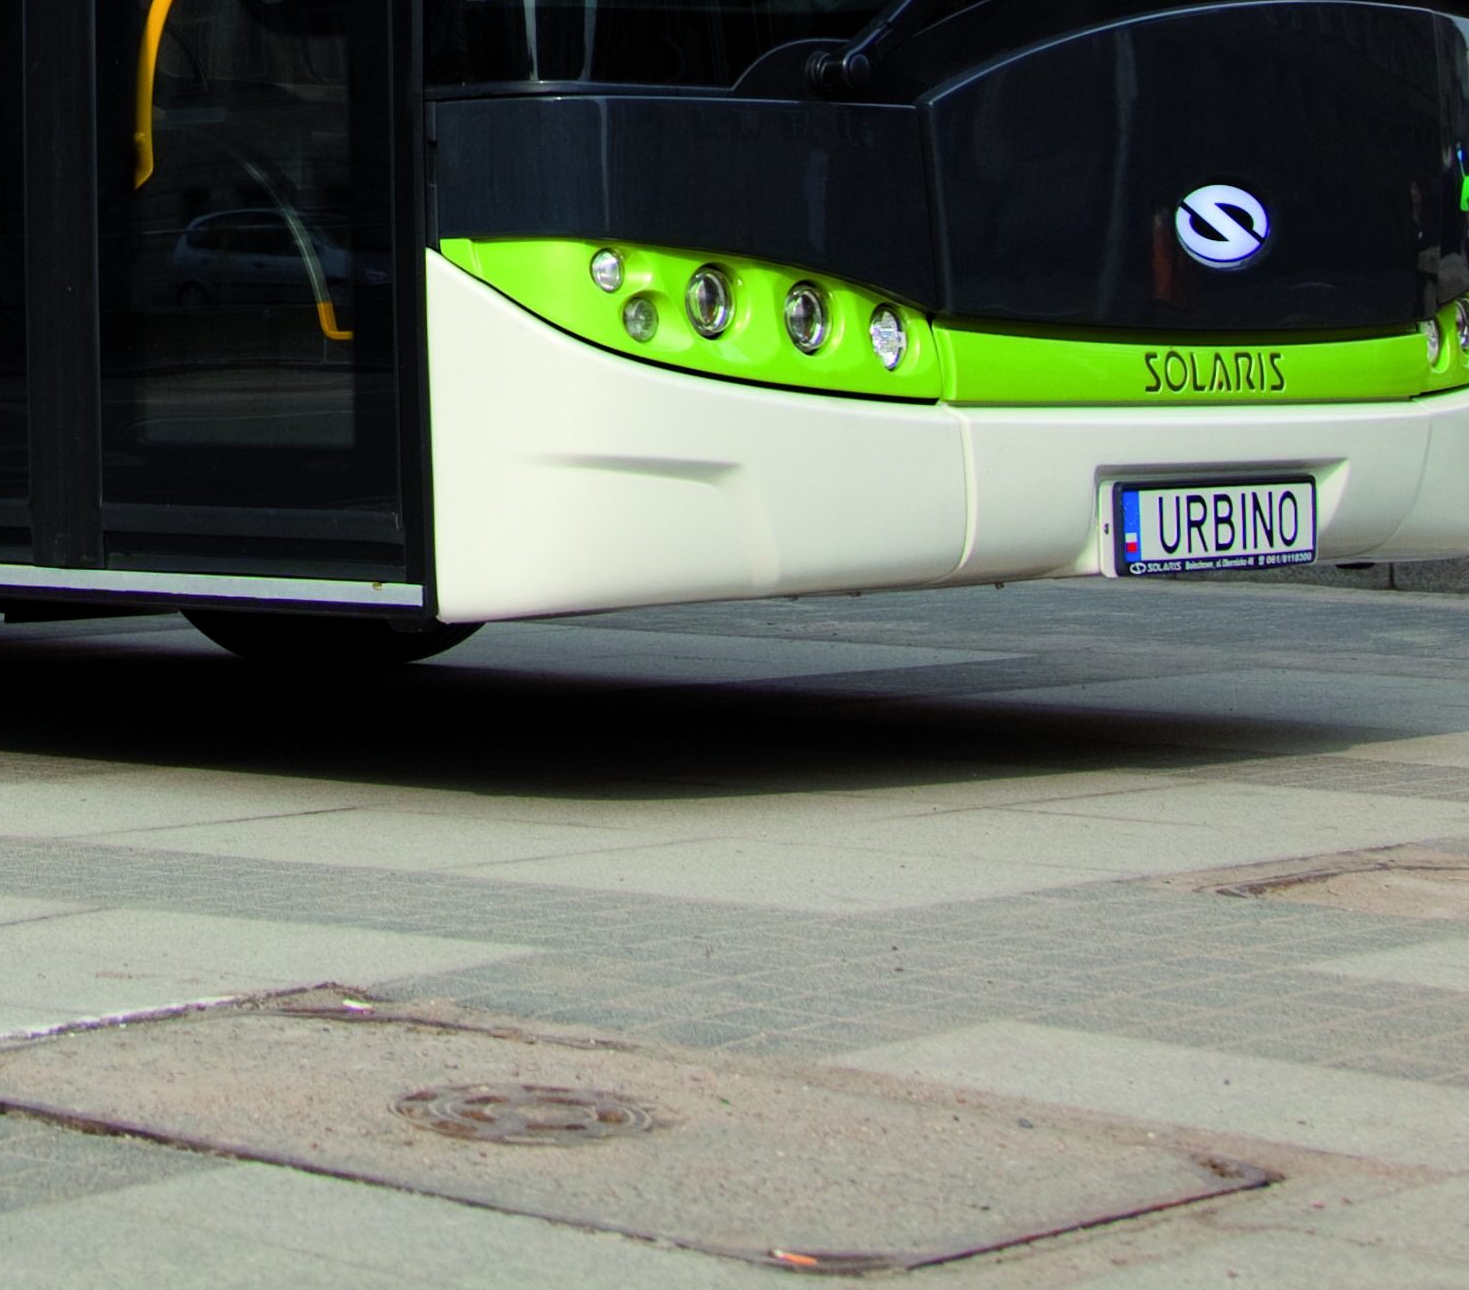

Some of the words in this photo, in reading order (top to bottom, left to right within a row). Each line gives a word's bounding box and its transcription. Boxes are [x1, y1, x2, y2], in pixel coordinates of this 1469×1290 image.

[1144, 348, 1288, 393] SOLARIS
[1158, 490, 1299, 554] URBINO
[1146, 561, 1182, 573] SOLARIS
